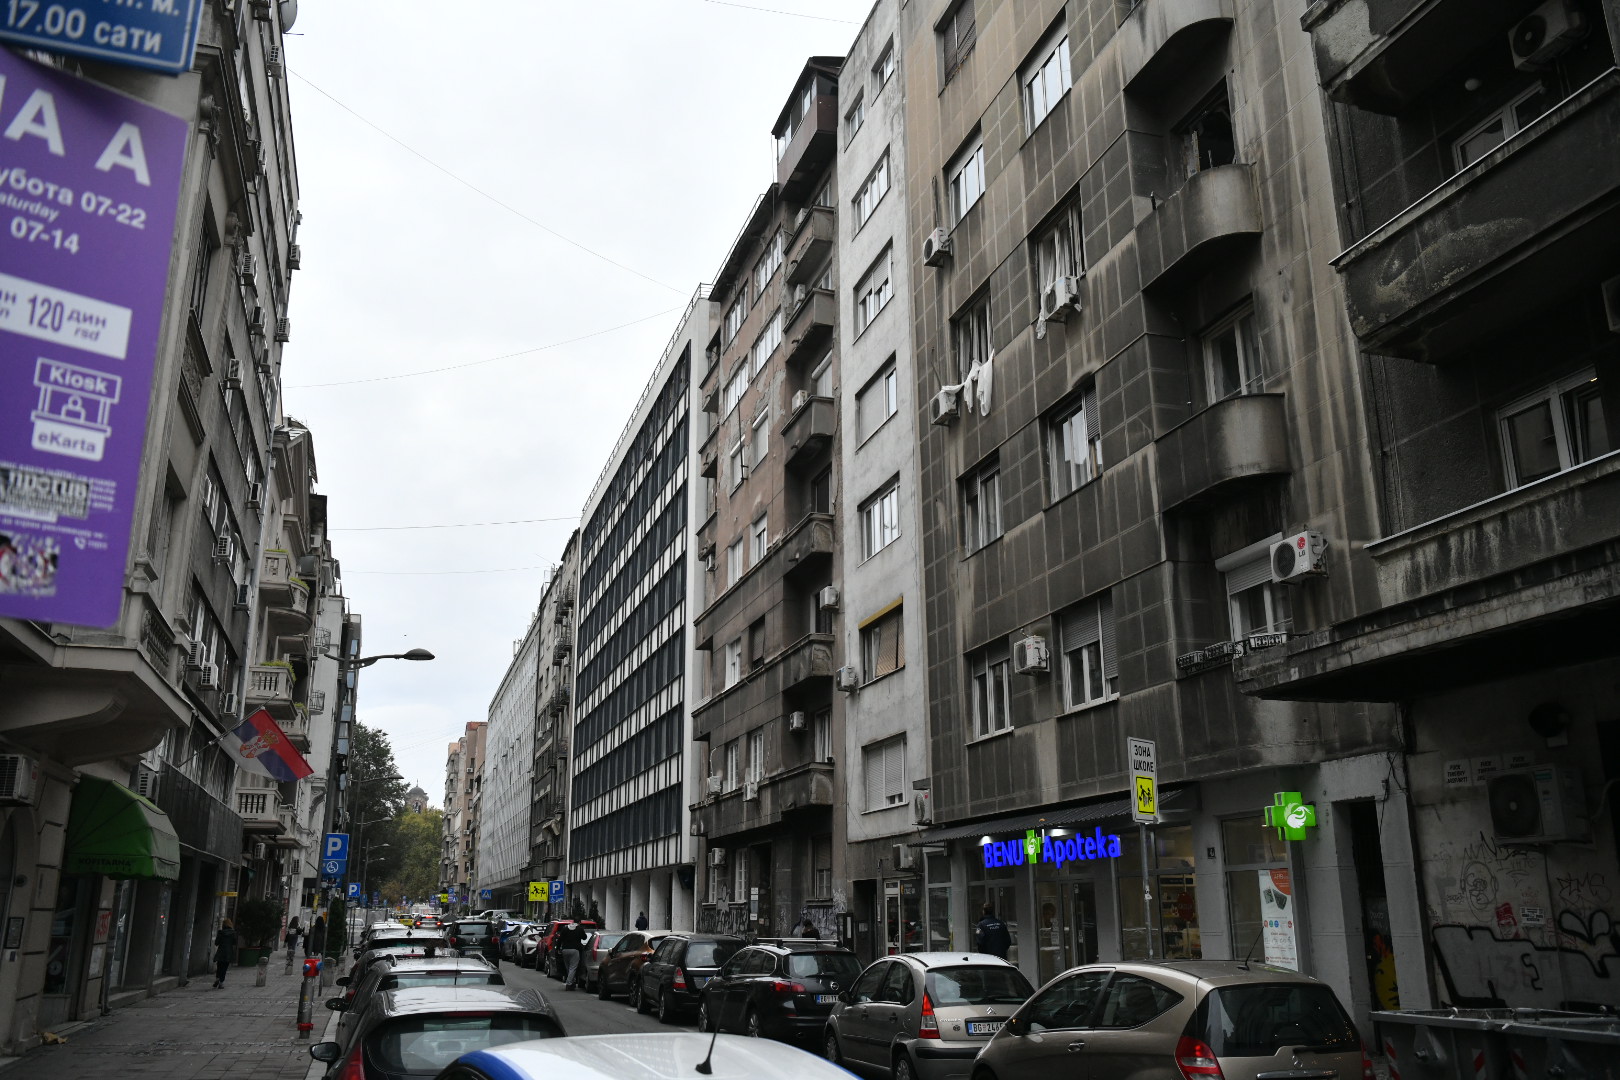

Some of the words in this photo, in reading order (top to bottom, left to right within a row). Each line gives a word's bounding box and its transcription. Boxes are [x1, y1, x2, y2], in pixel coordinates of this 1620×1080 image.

[7, 0, 87, 39] 17.00
[93, 20, 162, 54] сати
[80, 191, 147, 230] 07-22
[10, 215, 79, 255] 07-14
[27, 294, 64, 332] 120
[67, 308, 107, 328] дин
[74, 326, 101, 342] rsd
[49, 365, 108, 394] Kiosk
[38, 431, 96, 453] eKarta
[1134, 744, 1151, 757] ЗОНА
[1133, 759, 1154, 772] ШКОЛЕ
[326, 837, 342, 857] P
[983, 838, 1024, 868] BENU
[1042, 826, 1121, 869] Apoteka
[348, 884, 358, 896] P
[552, 882, 561, 894] P
[973, 1023, 982, 1032] BG
